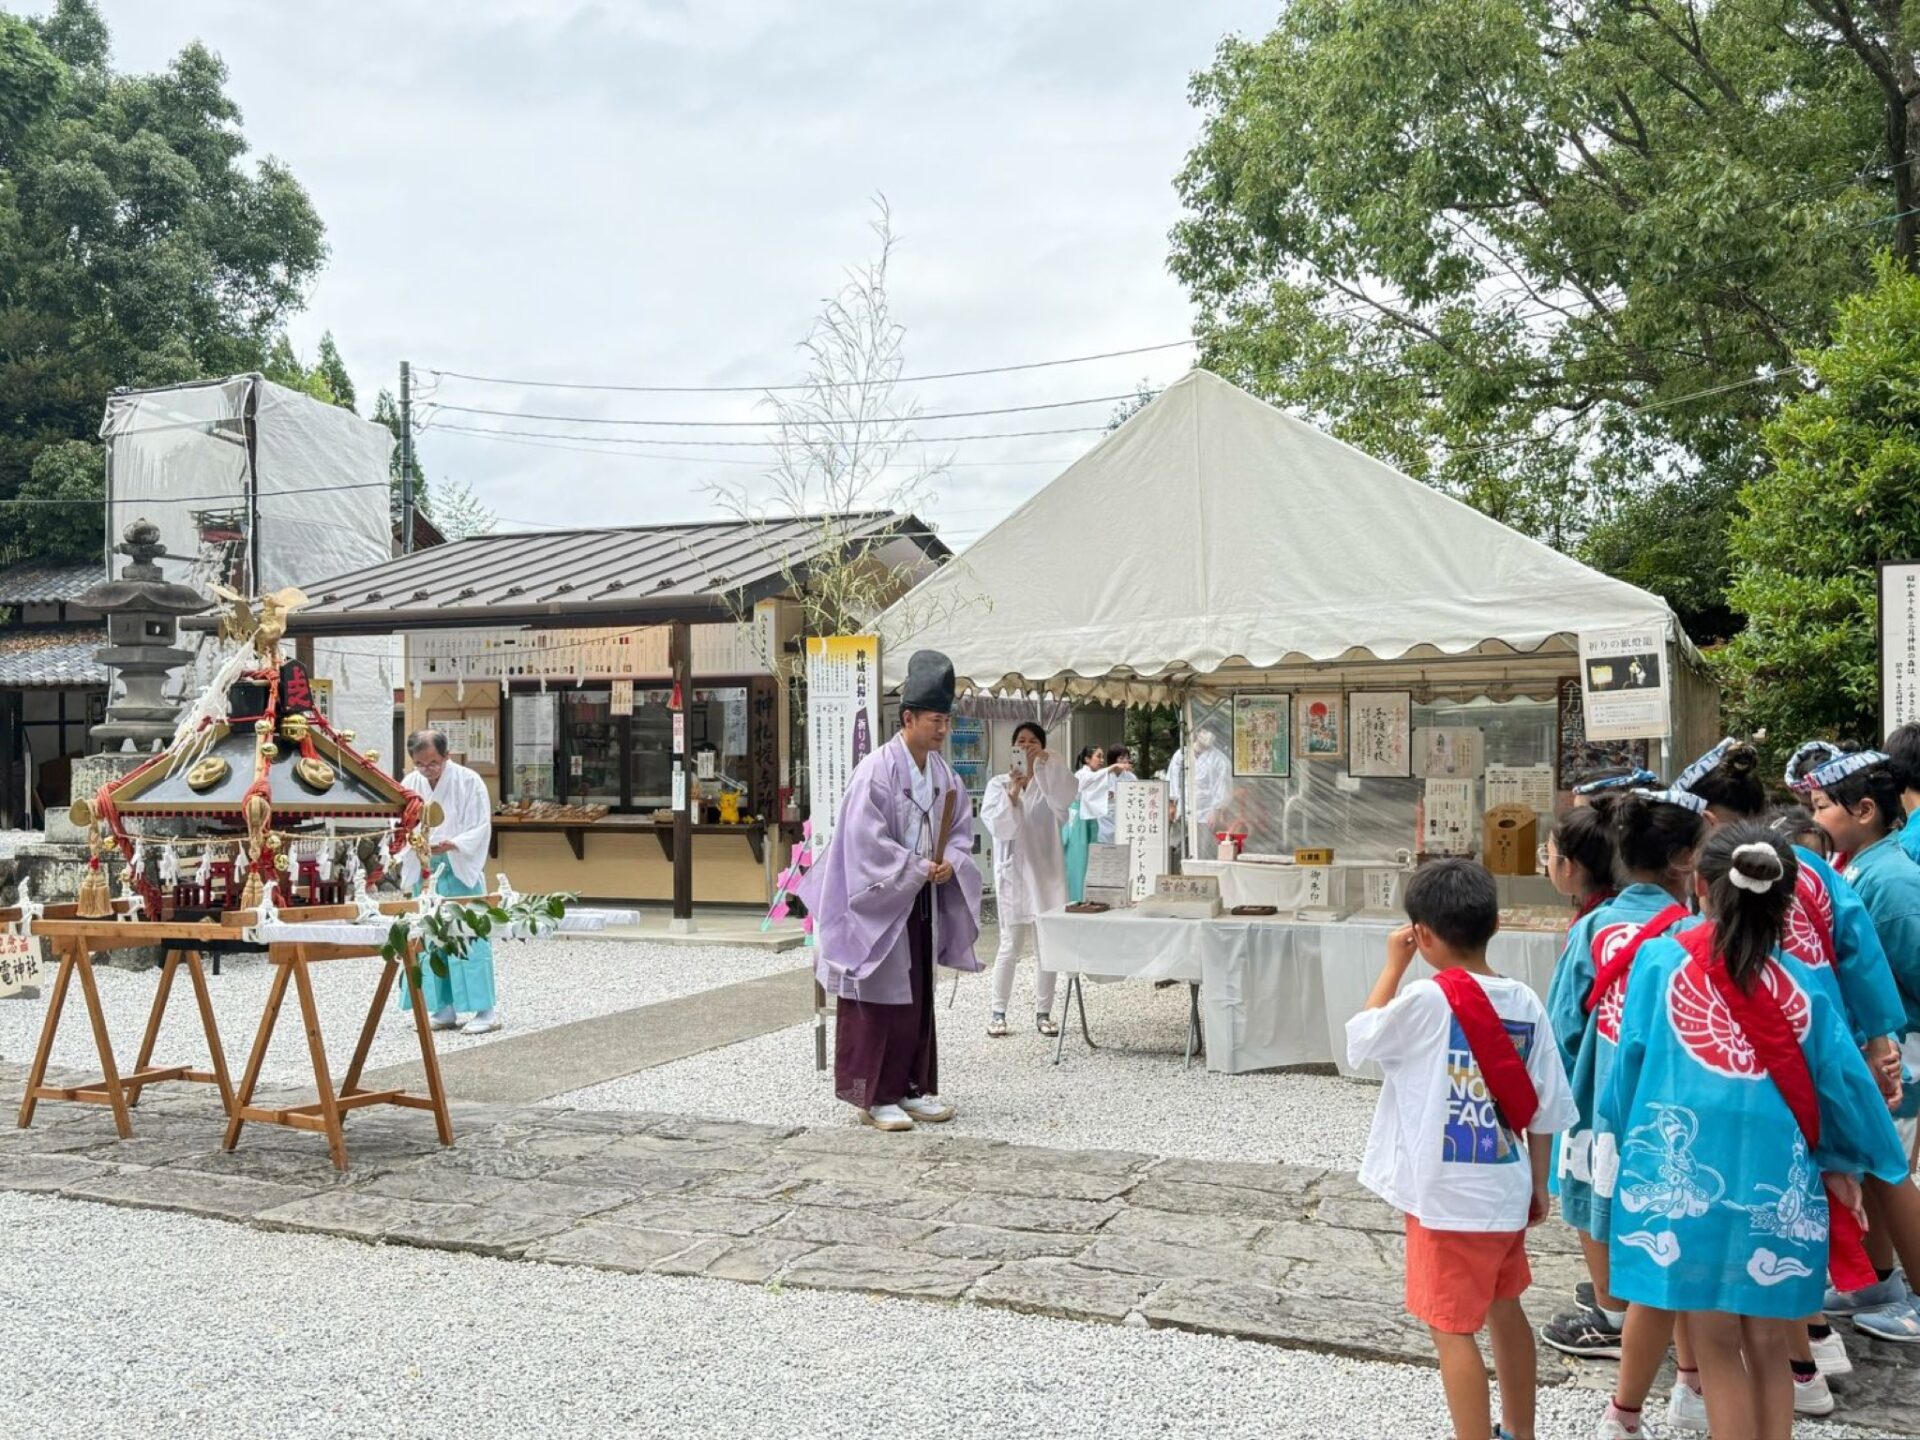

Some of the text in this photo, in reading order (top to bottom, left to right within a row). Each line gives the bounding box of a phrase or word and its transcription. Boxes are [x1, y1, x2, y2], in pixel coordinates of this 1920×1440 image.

[1137, 786, 1146, 896] こちらのテント内に
